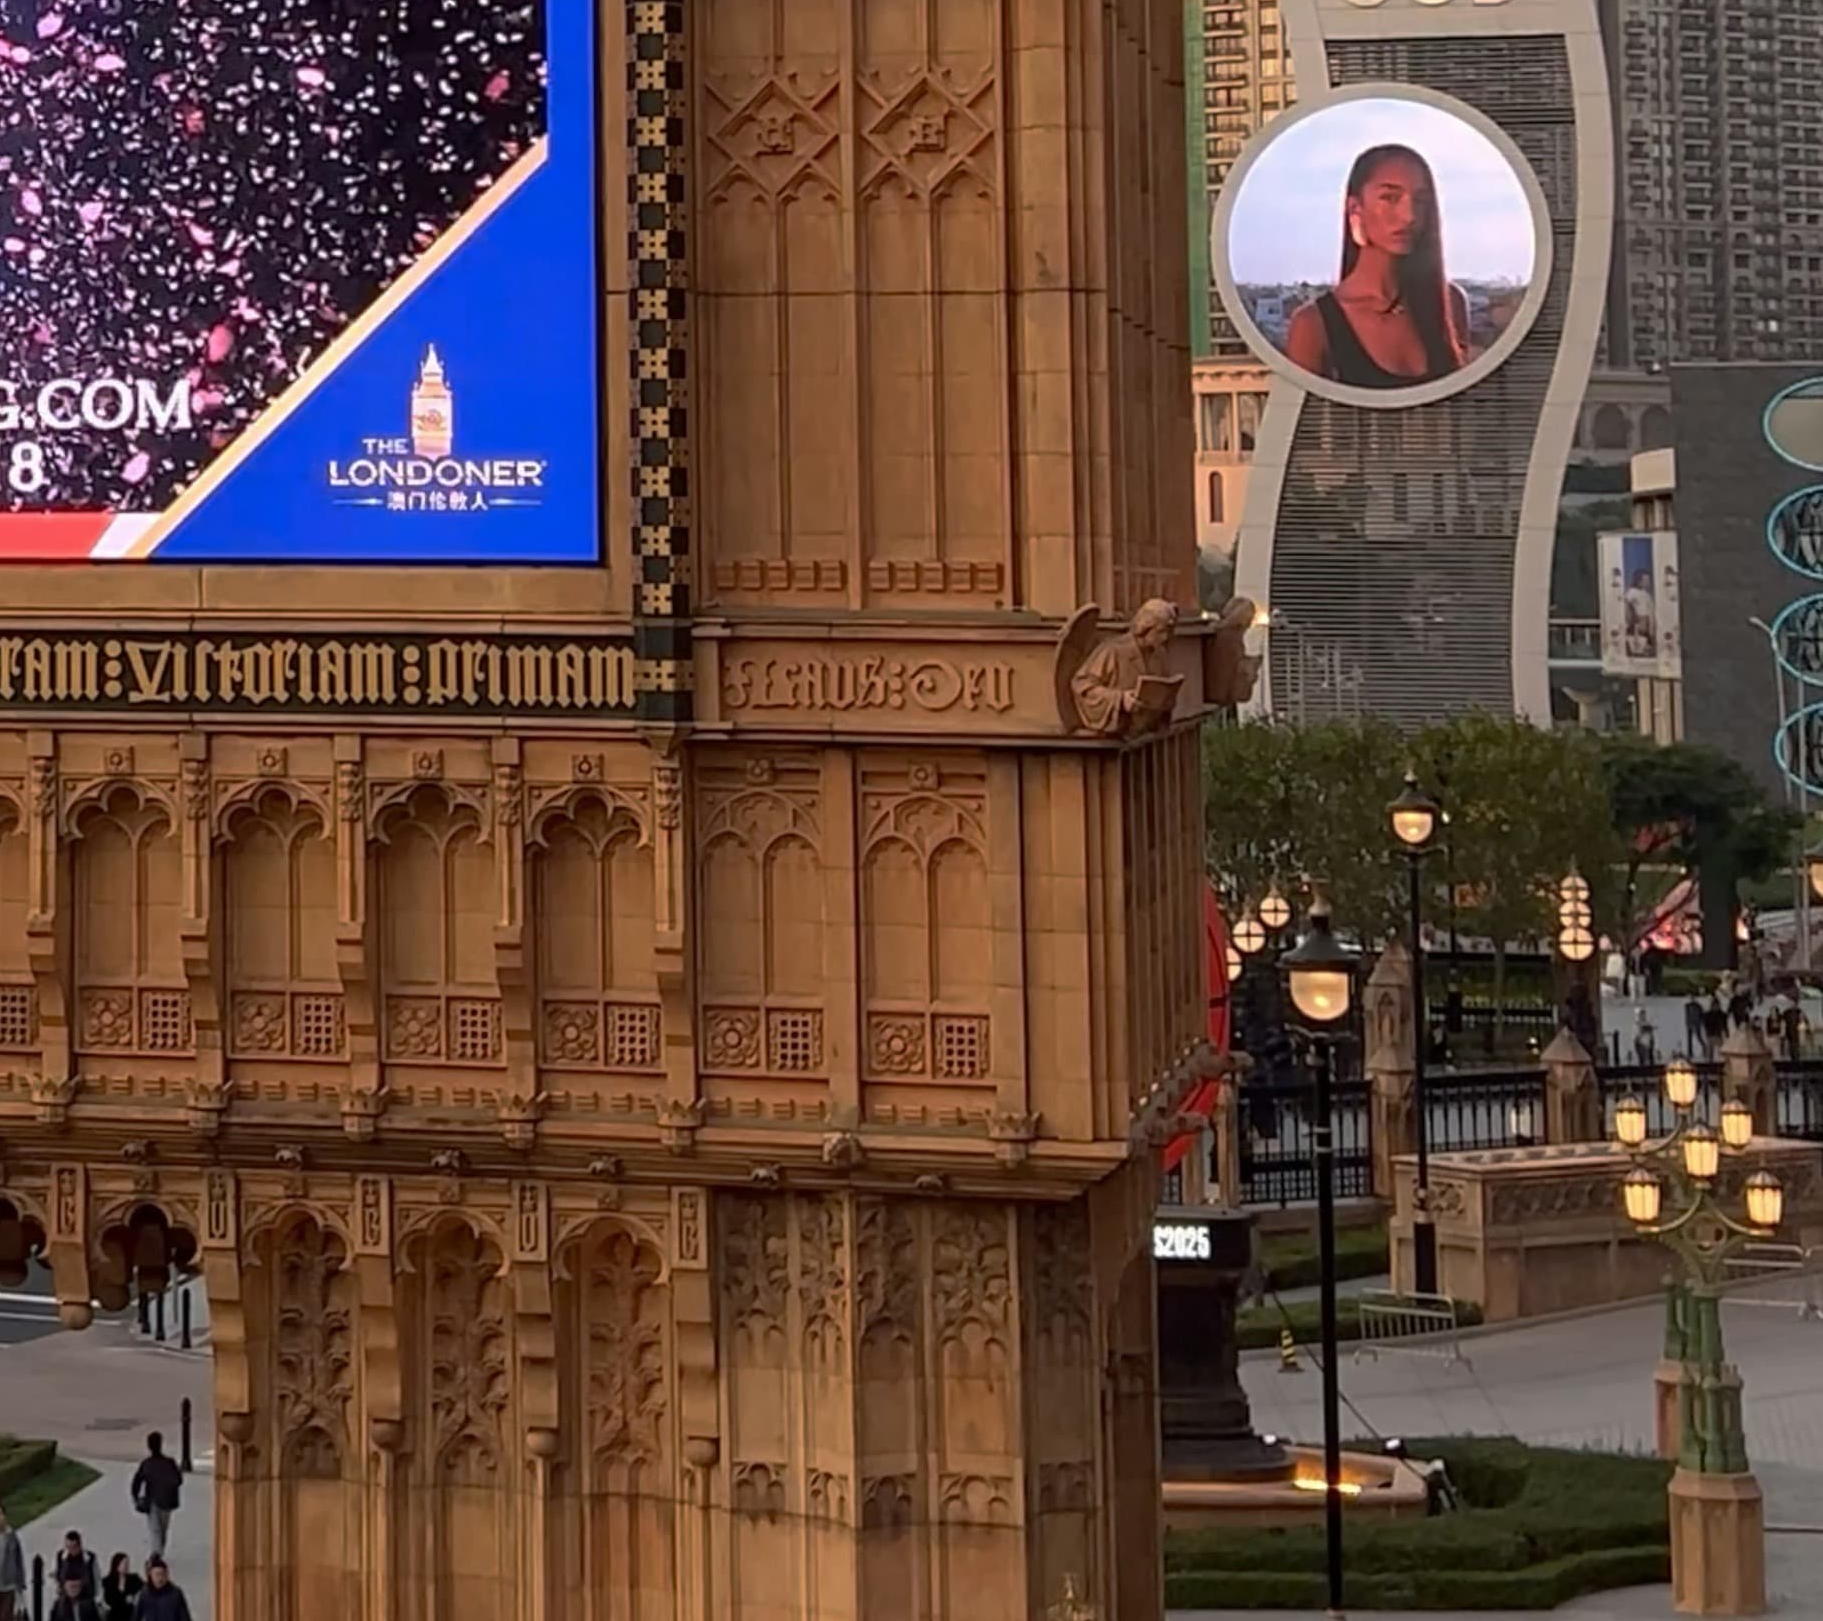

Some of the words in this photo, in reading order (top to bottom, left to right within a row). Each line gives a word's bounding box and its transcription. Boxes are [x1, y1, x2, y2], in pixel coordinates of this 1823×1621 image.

[362, 438, 409, 455] THE
[329, 459, 543, 487] LONDONER
[387, 491, 488, 511] 澳门伦敦人
